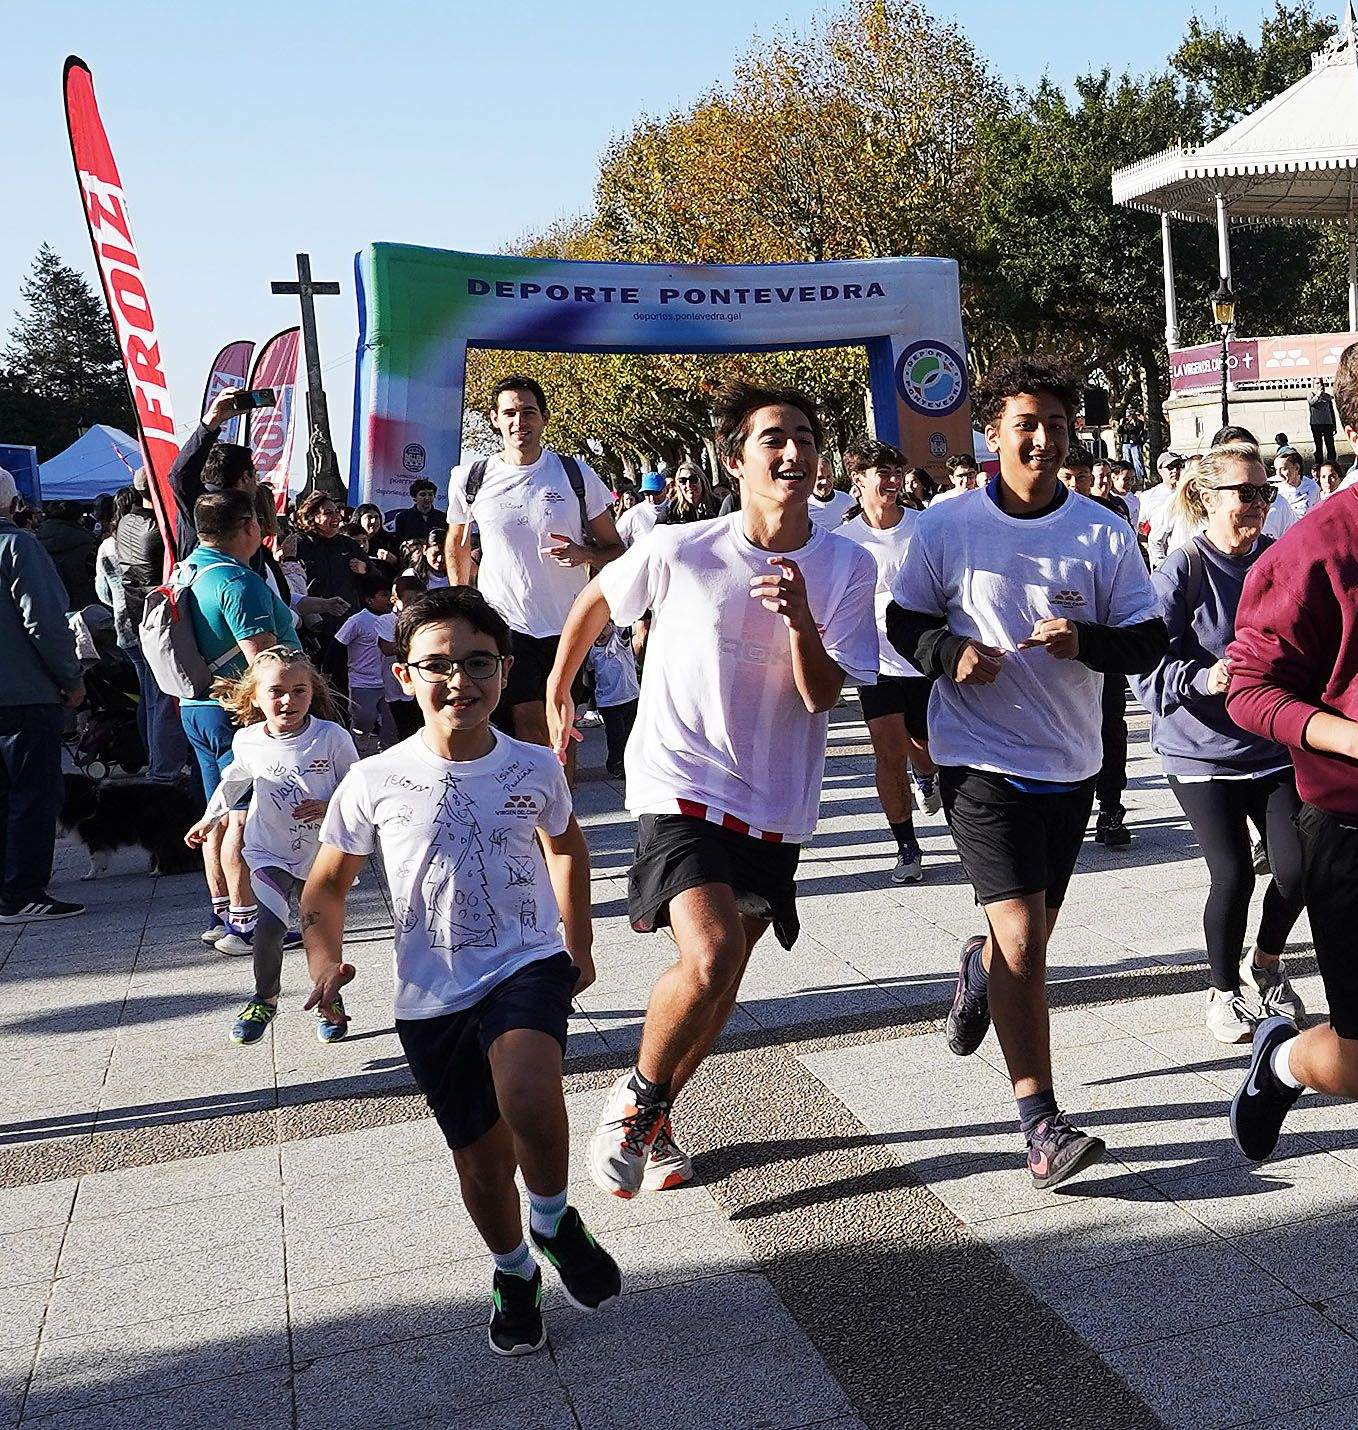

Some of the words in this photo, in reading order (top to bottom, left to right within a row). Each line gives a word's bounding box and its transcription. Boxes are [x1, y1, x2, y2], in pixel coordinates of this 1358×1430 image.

[466, 278, 640, 304] DEPORTE
[659, 281, 887, 305] PONTEVEDRA
[83, 187, 176, 436] FROIZ
[633, 311, 742, 322] deportes.pontevedra.gal
[907, 350, 955, 368] DEPORTE
[905, 380, 961, 408] PONTEVEDRA
